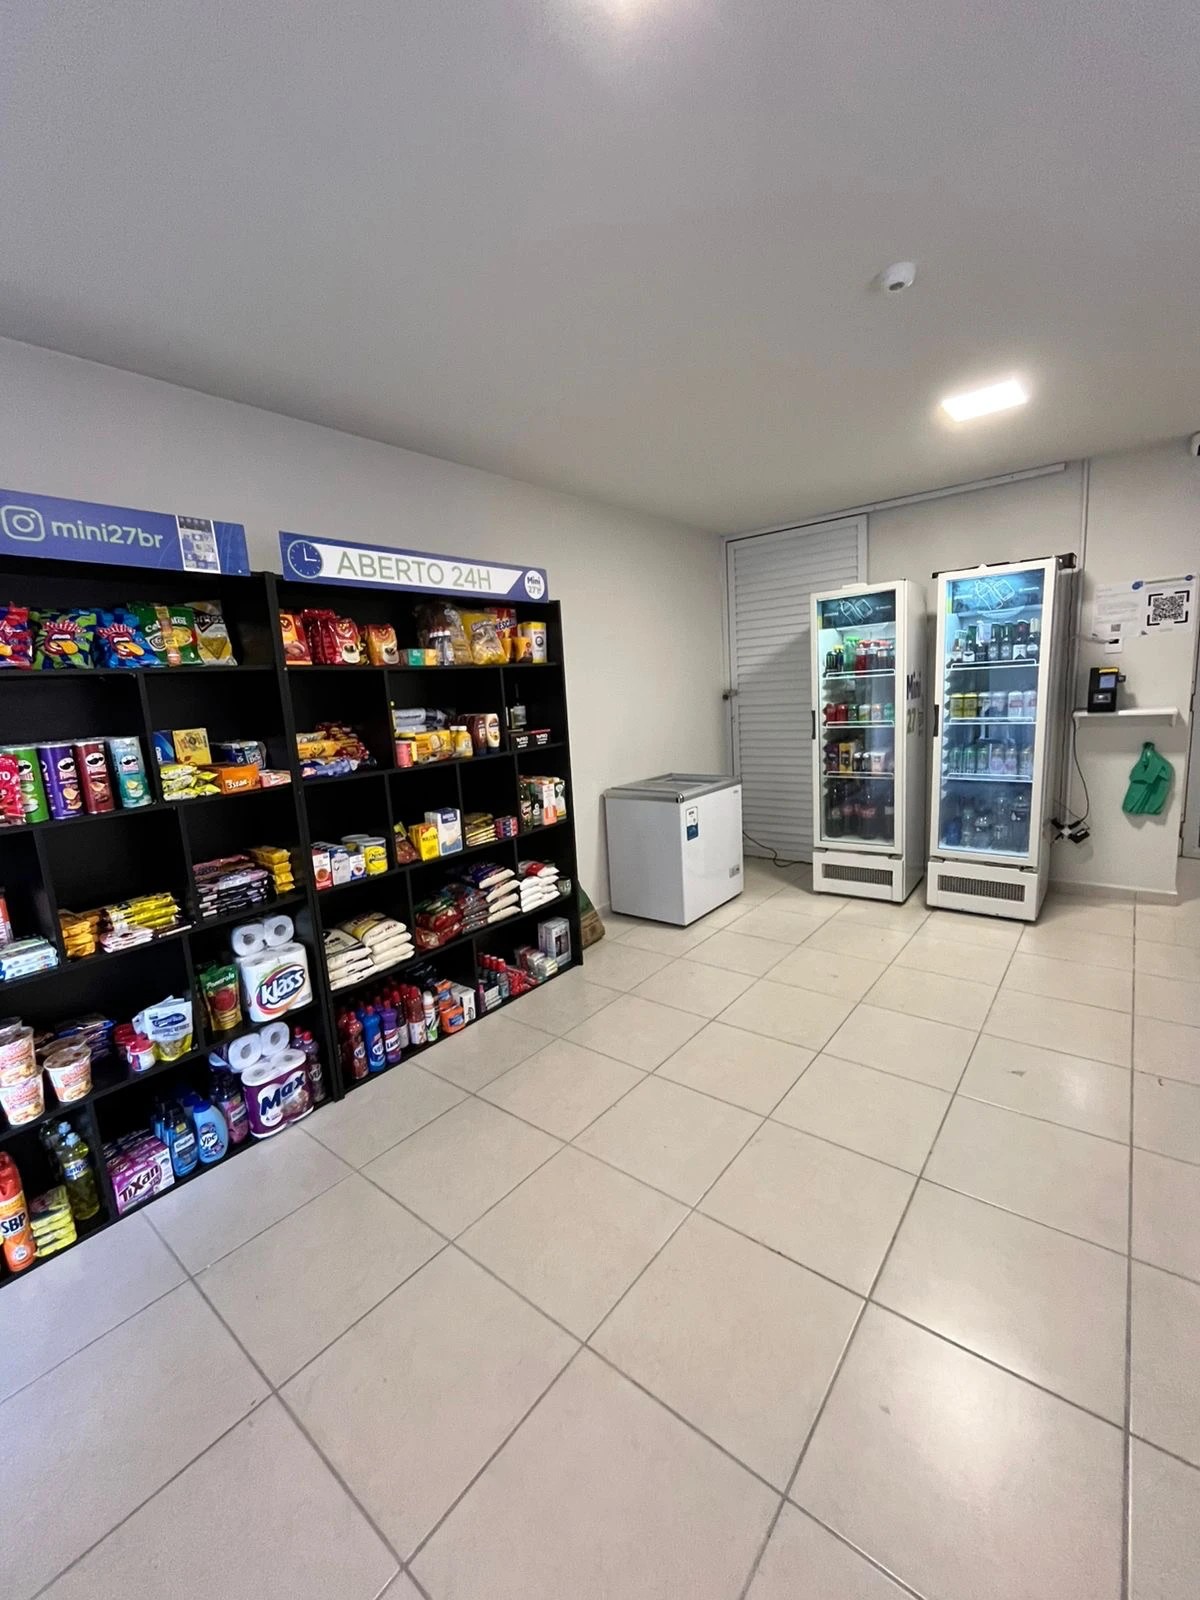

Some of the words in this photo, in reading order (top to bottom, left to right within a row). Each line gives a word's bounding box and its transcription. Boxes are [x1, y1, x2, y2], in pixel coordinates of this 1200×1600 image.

[51, 520, 163, 548] mini27br
[336, 551, 444, 585] ABERTO
[452, 566, 491, 590] 24H
[261, 1072, 305, 1116] Max
[0, 1212, 25, 1234] SBP
